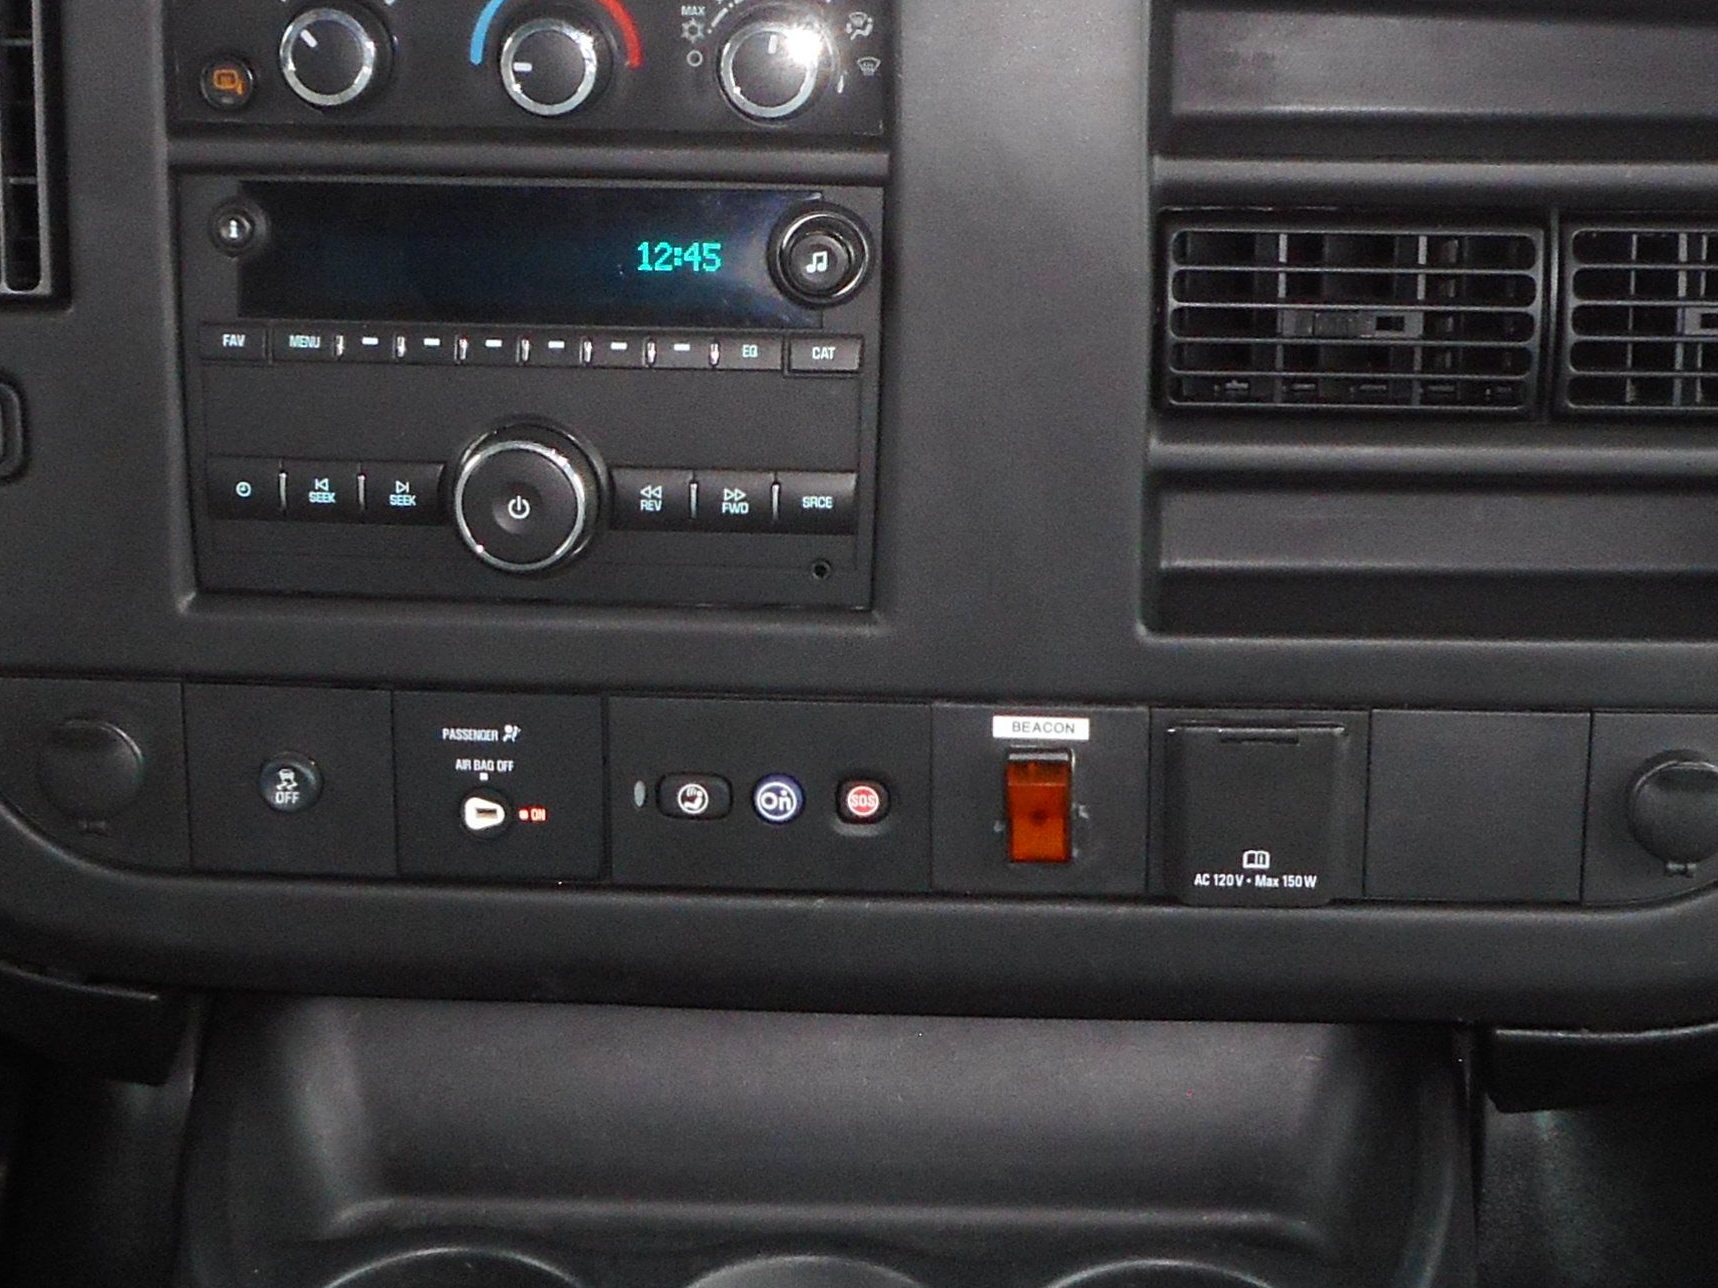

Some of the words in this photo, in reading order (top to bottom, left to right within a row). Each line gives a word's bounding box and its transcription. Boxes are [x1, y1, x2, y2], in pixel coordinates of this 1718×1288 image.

[681, 5, 706, 17] MAX
[637, 241, 722, 272] 12:45
[222, 333, 246, 348] FAV
[288, 334, 322, 349] MENU
[741, 343, 759, 358] EQ
[811, 346, 836, 360] CAT
[308, 491, 336, 504] SEEK
[389, 494, 417, 507] SEEK
[801, 496, 834, 510] SRCE
[640, 499, 663, 512] REV
[721, 502, 750, 515] FWD
[1011, 720, 1076, 734] BEACON
[441, 727, 499, 742] PASSENGER
[455, 758, 472, 771] AIR
[473, 759, 495, 772] BAG
[496, 759, 514, 772] OFF
[275, 791, 300, 804] OFF
[850, 793, 877, 809] SOS
[530, 808, 547, 822] ON
[1194, 873, 1211, 887] AC
[1254, 874, 1280, 889] Max
